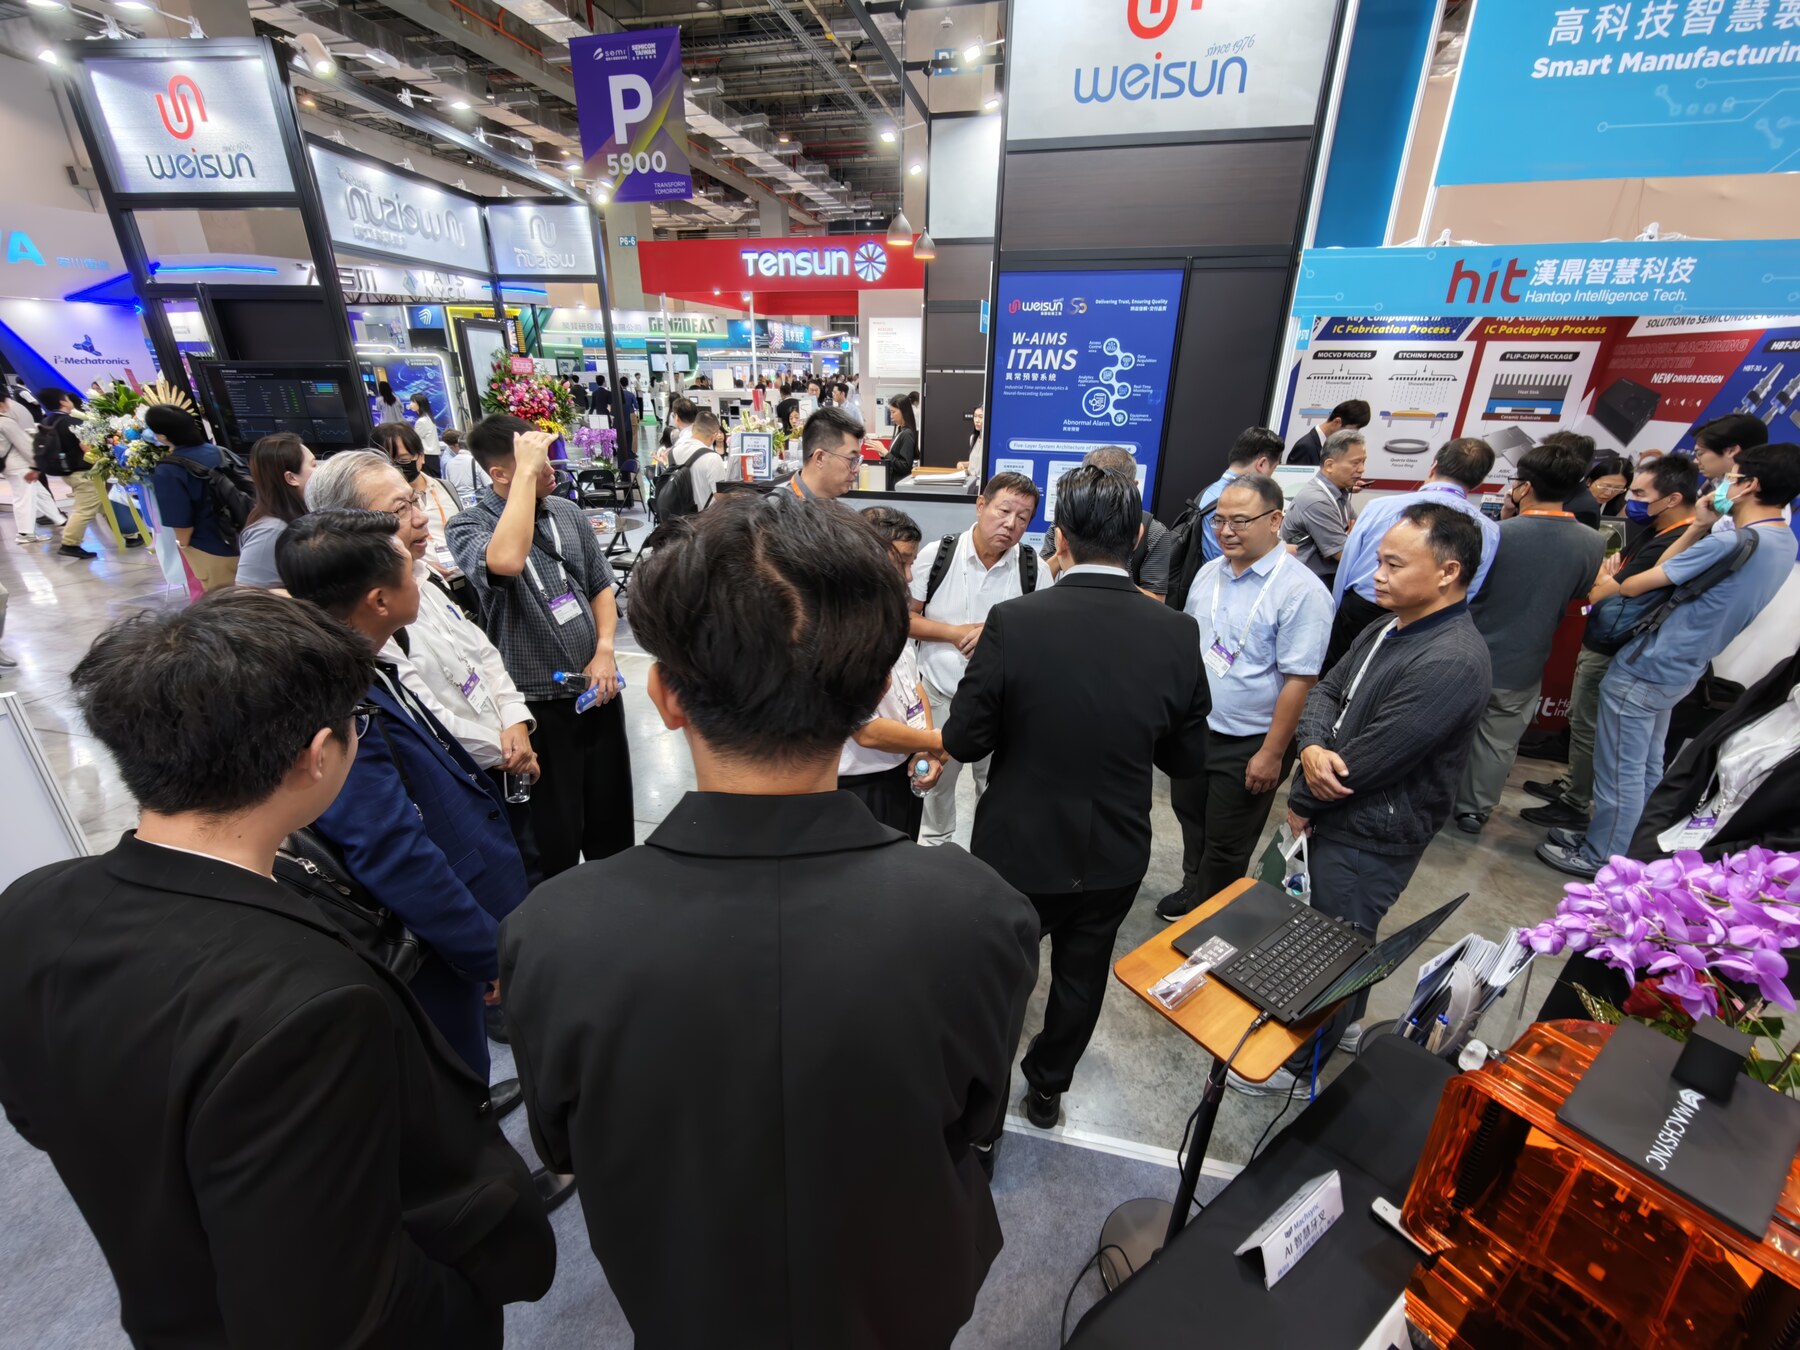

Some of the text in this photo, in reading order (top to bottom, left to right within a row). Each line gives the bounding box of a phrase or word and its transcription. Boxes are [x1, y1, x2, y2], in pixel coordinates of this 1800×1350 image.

[605, 49, 626, 57] semi
[631, 43, 656, 51] SEMICON
[1205, 33, 1256, 58] since 1976
[1531, 56, 1613, 79] Smart
[1074, 52, 1248, 105] weisun
[608, 73, 653, 145] P
[145, 147, 256, 180] weisun
[607, 150, 667, 176] 5900
[619, 236, 636, 246] P6-6
[1529, 256, 1698, 286] 漢鼎智慧科技
[1446, 257, 1529, 304] hit
[1525, 289, 1687, 304] Hantop Intelligence Tech.
[1022, 299, 1063, 312] weisun
[1332, 324, 1450, 334] IC Fabrication Process
[1484, 324, 1607, 336] IC Packaging Process
[1646, 317, 1685, 328] SOLUTION
[1686, 317, 1695, 325] to
[1012, 332, 1068, 345] W-AIMS
[1675, 339, 1749, 354] MACHINING
[1007, 348, 1079, 371] ITANS
[1651, 357, 1695, 369] SYSTEM
[1005, 372, 1057, 382] 異常預警系統
[1650, 373, 1724, 384] NEW DRIVER DESIGN
[1534, 696, 1556, 717] it
[1645, 1100, 1696, 1171] MACHSYNC
[1293, 1202, 1320, 1229] Machsync
[1285, 1243, 1293, 1259] AI
